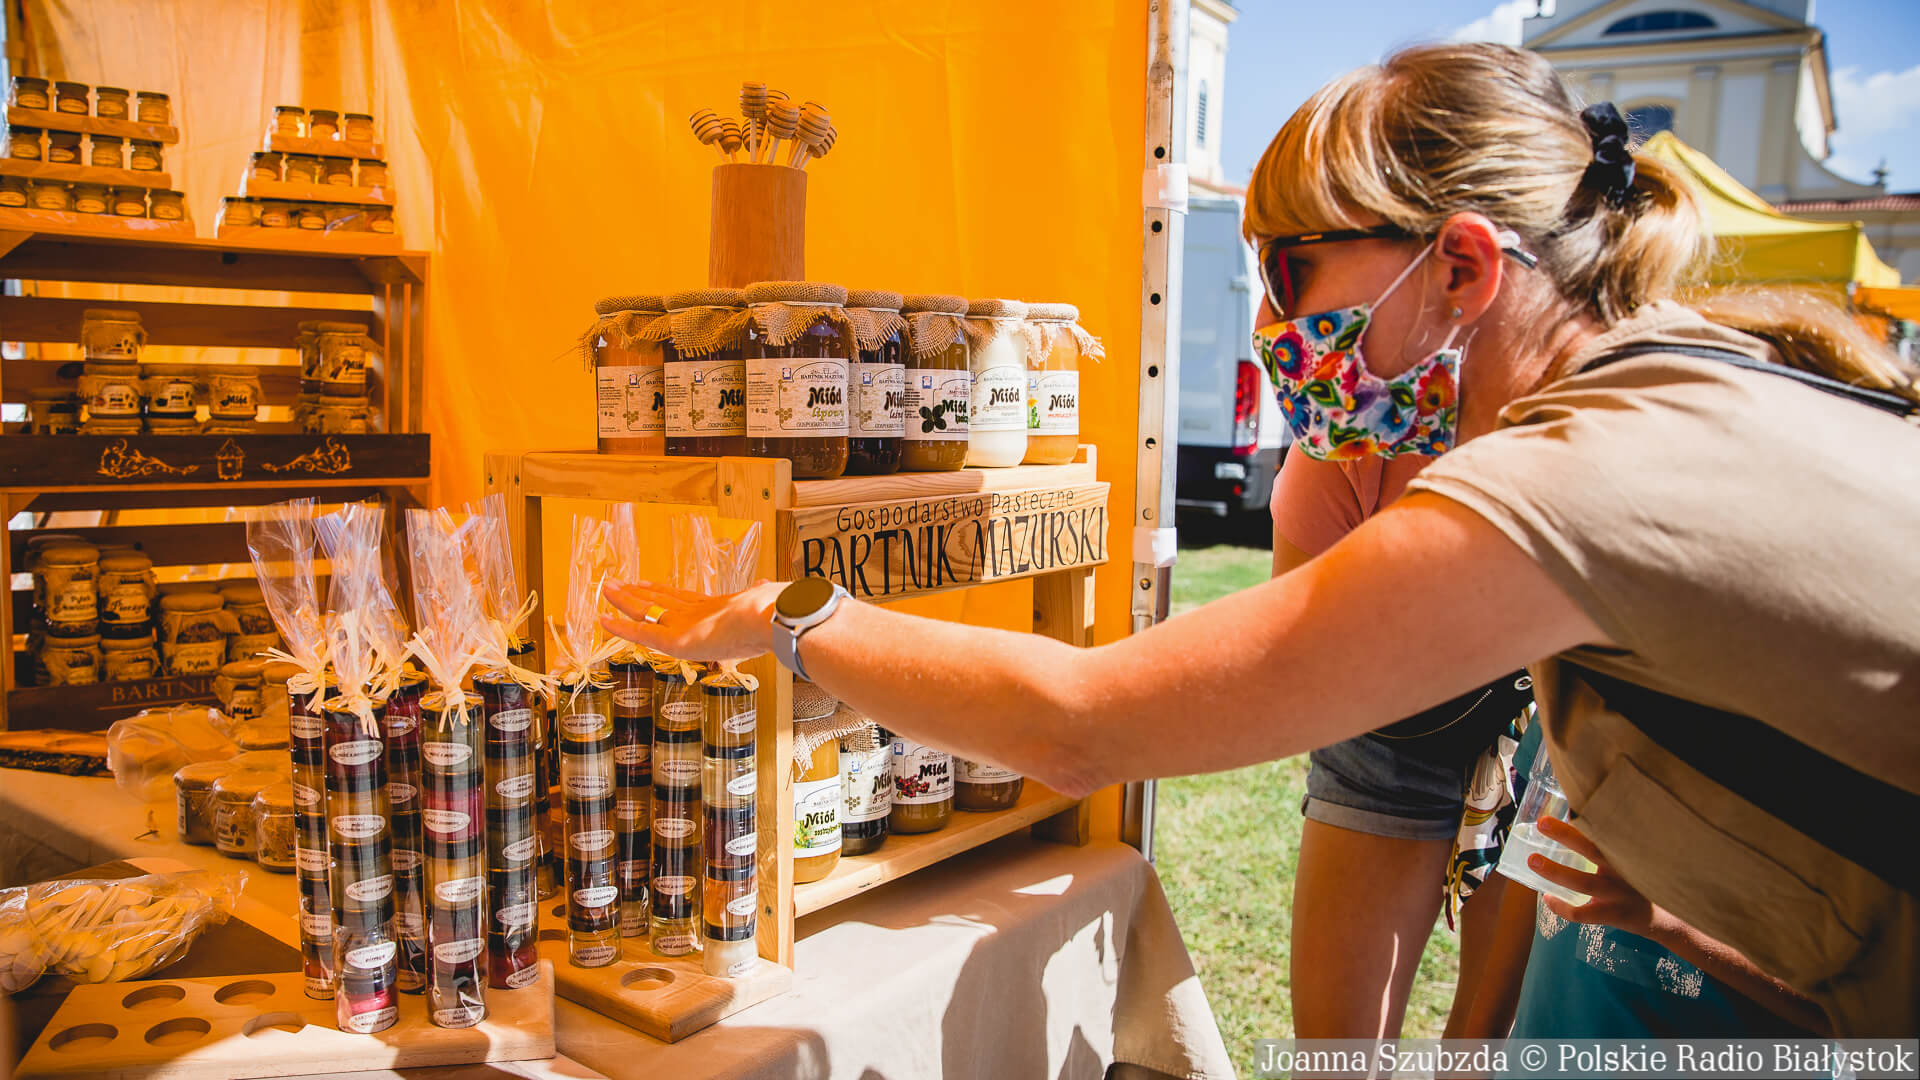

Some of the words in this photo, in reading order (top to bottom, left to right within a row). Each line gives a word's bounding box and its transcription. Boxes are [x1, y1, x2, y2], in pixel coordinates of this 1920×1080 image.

[807, 386, 842, 408] Miód
[989, 386, 1020, 406] Miód
[1048, 393, 1075, 411] Miód
[942, 399, 967, 414] Miód
[837, 496, 984, 533] Gospodarstwo
[991, 489, 1074, 514] Pasieczne
[802, 522, 959, 598] BARTNIK
[968, 505, 1104, 582] MAZURSKI
[918, 761, 947, 781] Miód
[804, 808, 835, 828] Miód
